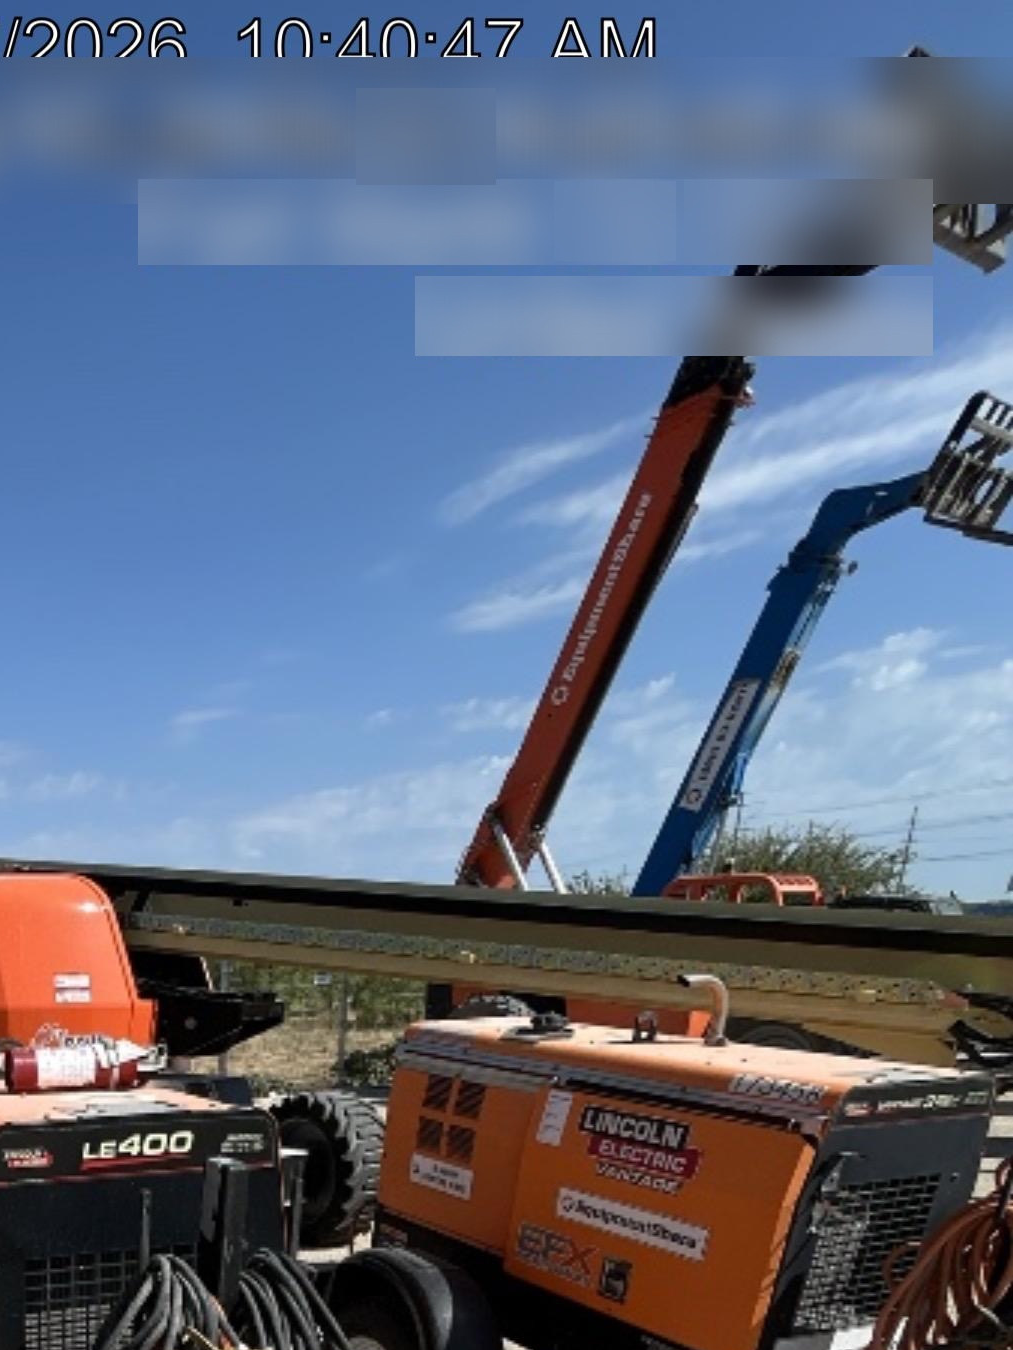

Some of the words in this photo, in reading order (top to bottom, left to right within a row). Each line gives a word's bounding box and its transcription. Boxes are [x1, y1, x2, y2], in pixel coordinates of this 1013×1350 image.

[82, 1130, 195, 1160] LE400
[583, 1108, 685, 1150] LINCOLN
[598, 1139, 688, 1174] ELECTRIC
